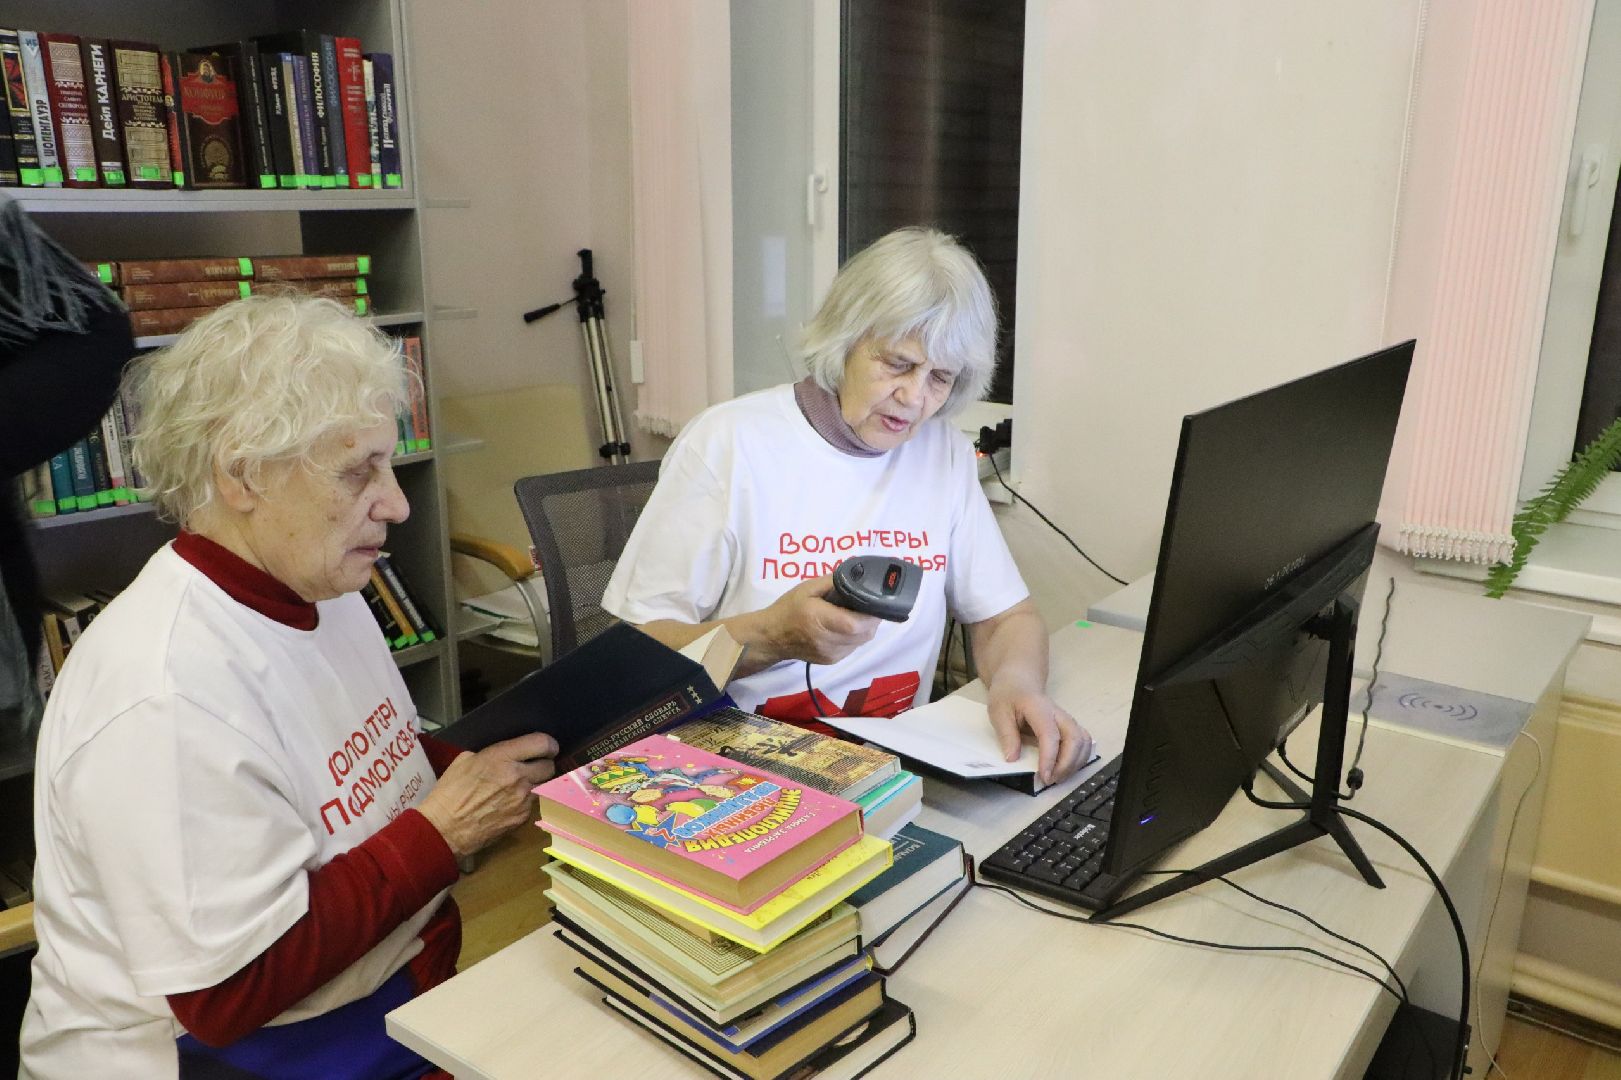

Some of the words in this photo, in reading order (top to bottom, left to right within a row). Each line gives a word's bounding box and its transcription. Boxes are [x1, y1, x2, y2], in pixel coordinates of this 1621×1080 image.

[90, 44, 109, 104] КАРНЕГИ
[311, 52, 325, 118] ФИЛОСОФИЯ
[121, 93, 163, 103] АРИСТОТЕЛЬ
[36, 99, 56, 157] ШОПЕНГАУЭР
[101, 106, 116, 141] Дейл
[779, 530, 929, 555] ВОЛОНТЕРЫ
[644, 700, 678, 723] СЛОВАРЬ
[684, 788, 802, 853] ЭНЦИКЛОПЕДИЯ
[705, 797, 776, 838] ЛЮБИМЫХ
